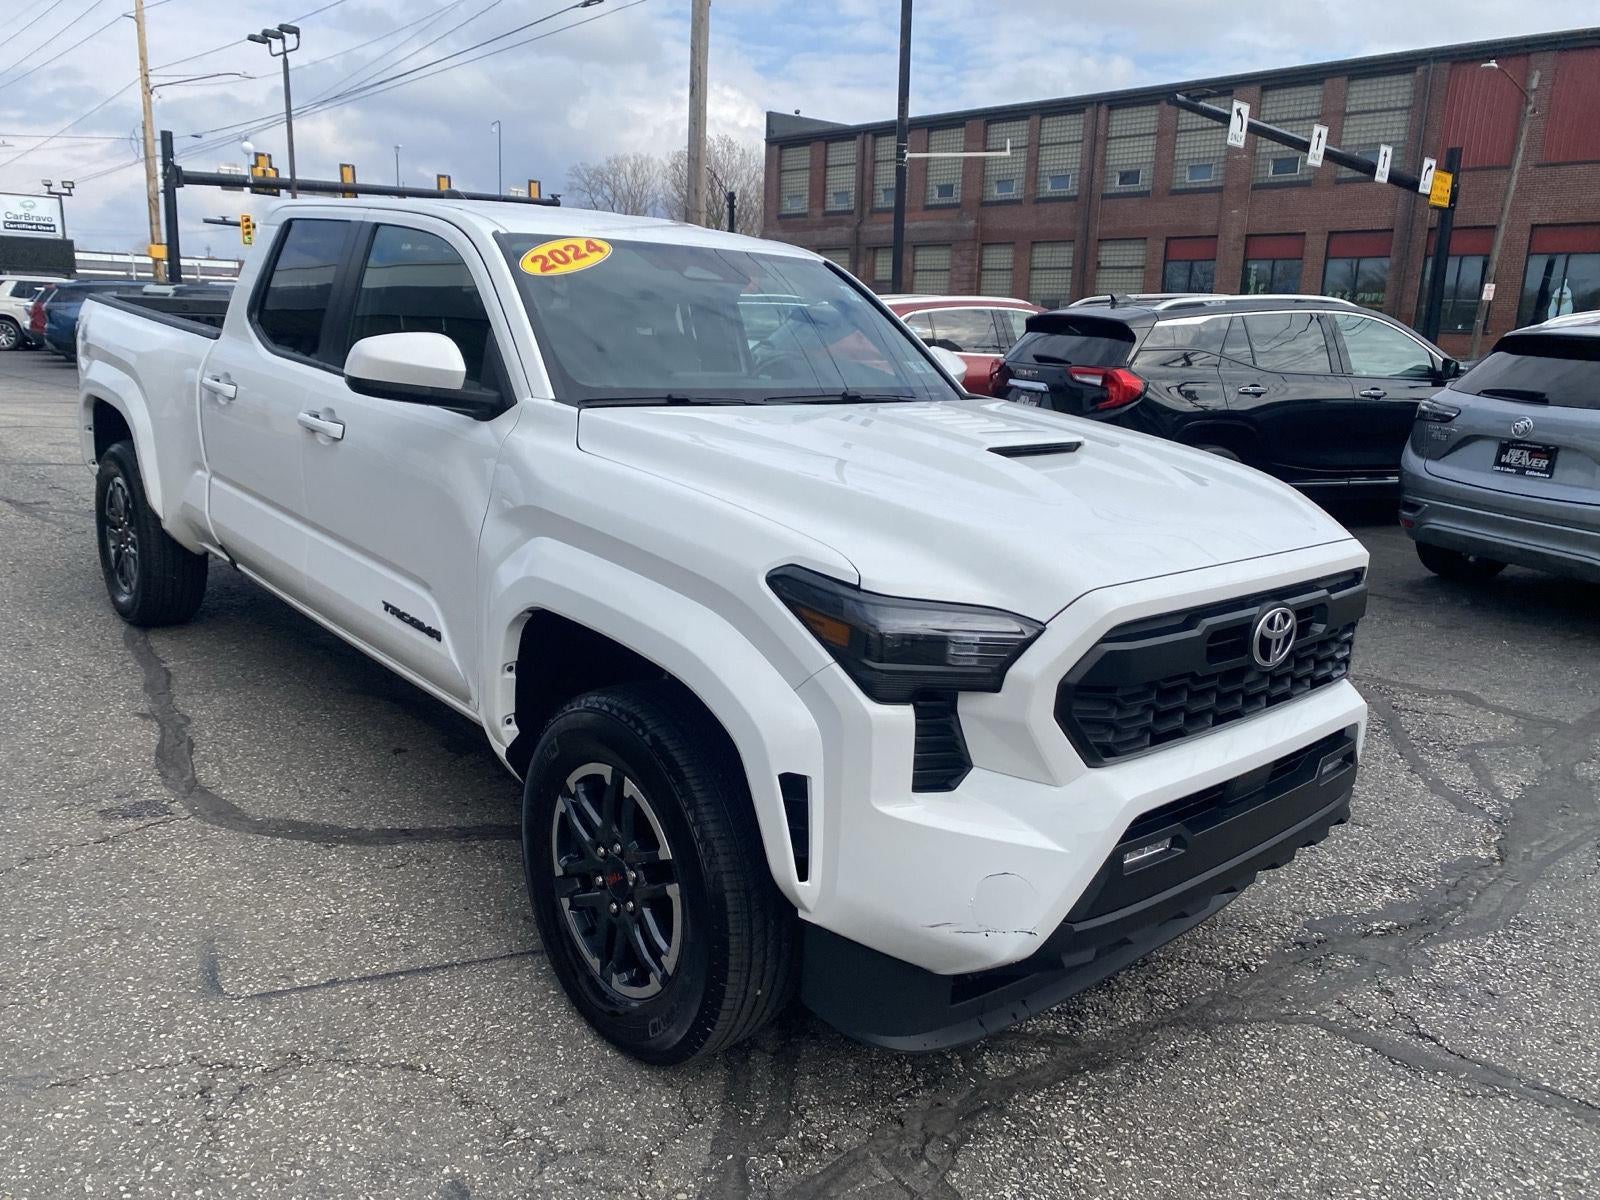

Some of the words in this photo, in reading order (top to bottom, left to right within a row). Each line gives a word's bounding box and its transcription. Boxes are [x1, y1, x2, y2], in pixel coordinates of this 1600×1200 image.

[4, 211, 53, 222] CarBravo
[530, 239, 605, 273] 2024
[1508, 448, 1531, 458] RICK
[1500, 454, 1549, 468] WEAVER
[381, 599, 442, 643] TACOMA
